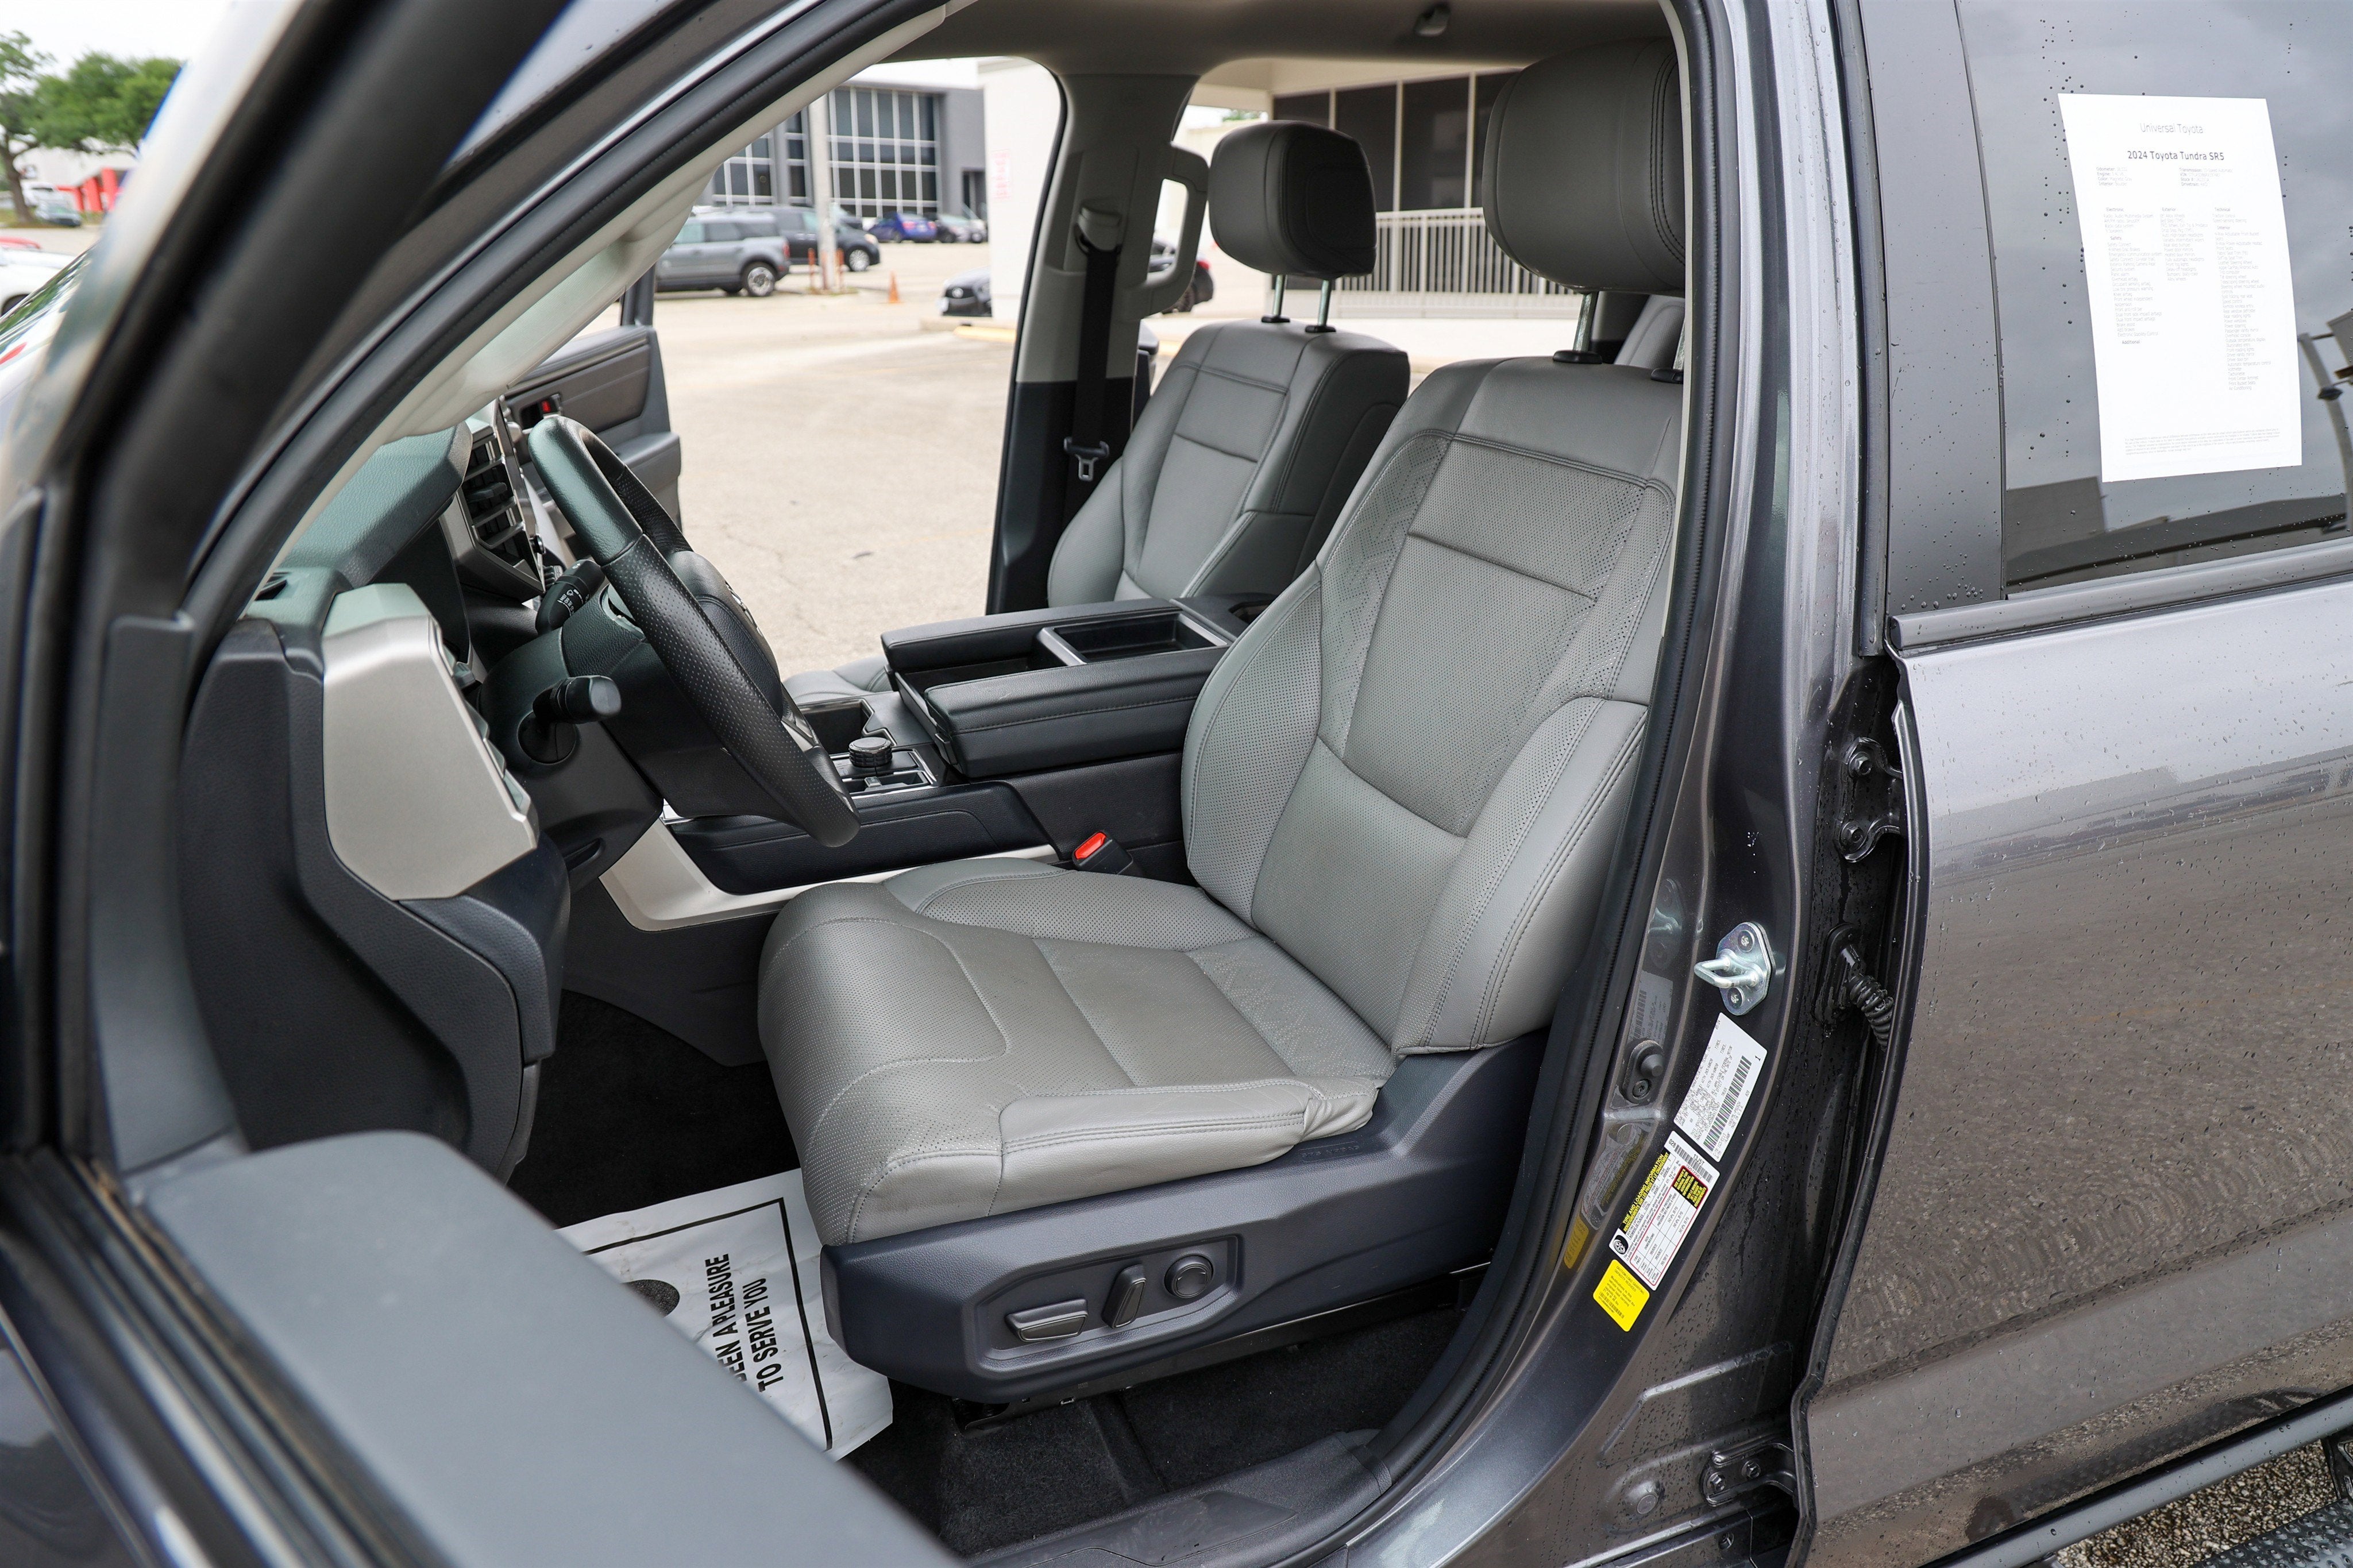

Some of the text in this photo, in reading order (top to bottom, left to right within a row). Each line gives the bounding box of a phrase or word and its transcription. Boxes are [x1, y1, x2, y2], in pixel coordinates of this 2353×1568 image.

[2139, 123, 2204, 136] Universal Toyota
[2127, 150, 2224, 161] 2024 Toyota Tundra SR5
[1668, 1138, 1677, 1148] 028
[1692, 1153, 1705, 1166] 13J5T
[1676, 1168, 1686, 1183] OWNER'S
[1679, 1174, 1691, 1192] ADDITIONAL
[1622, 1153, 1664, 1225] TIRE AND LOADING INFORMATION
[1676, 1177, 1685, 1190] MANUAL
[1681, 1175, 1695, 1196] INFORMATION
[1623, 1204, 1640, 1233] RENSEIGNEMENTS
[1645, 1180, 1653, 1194] PNEUS
[1655, 1151, 1669, 1175] CHARGEMENT
[1663, 1193, 1672, 1208] PRESSURE
[705, 1254, 736, 1327] PLEASURE
[713, 1321, 738, 1337] A
[742, 1278, 784, 1392] TO SERVE YOU
